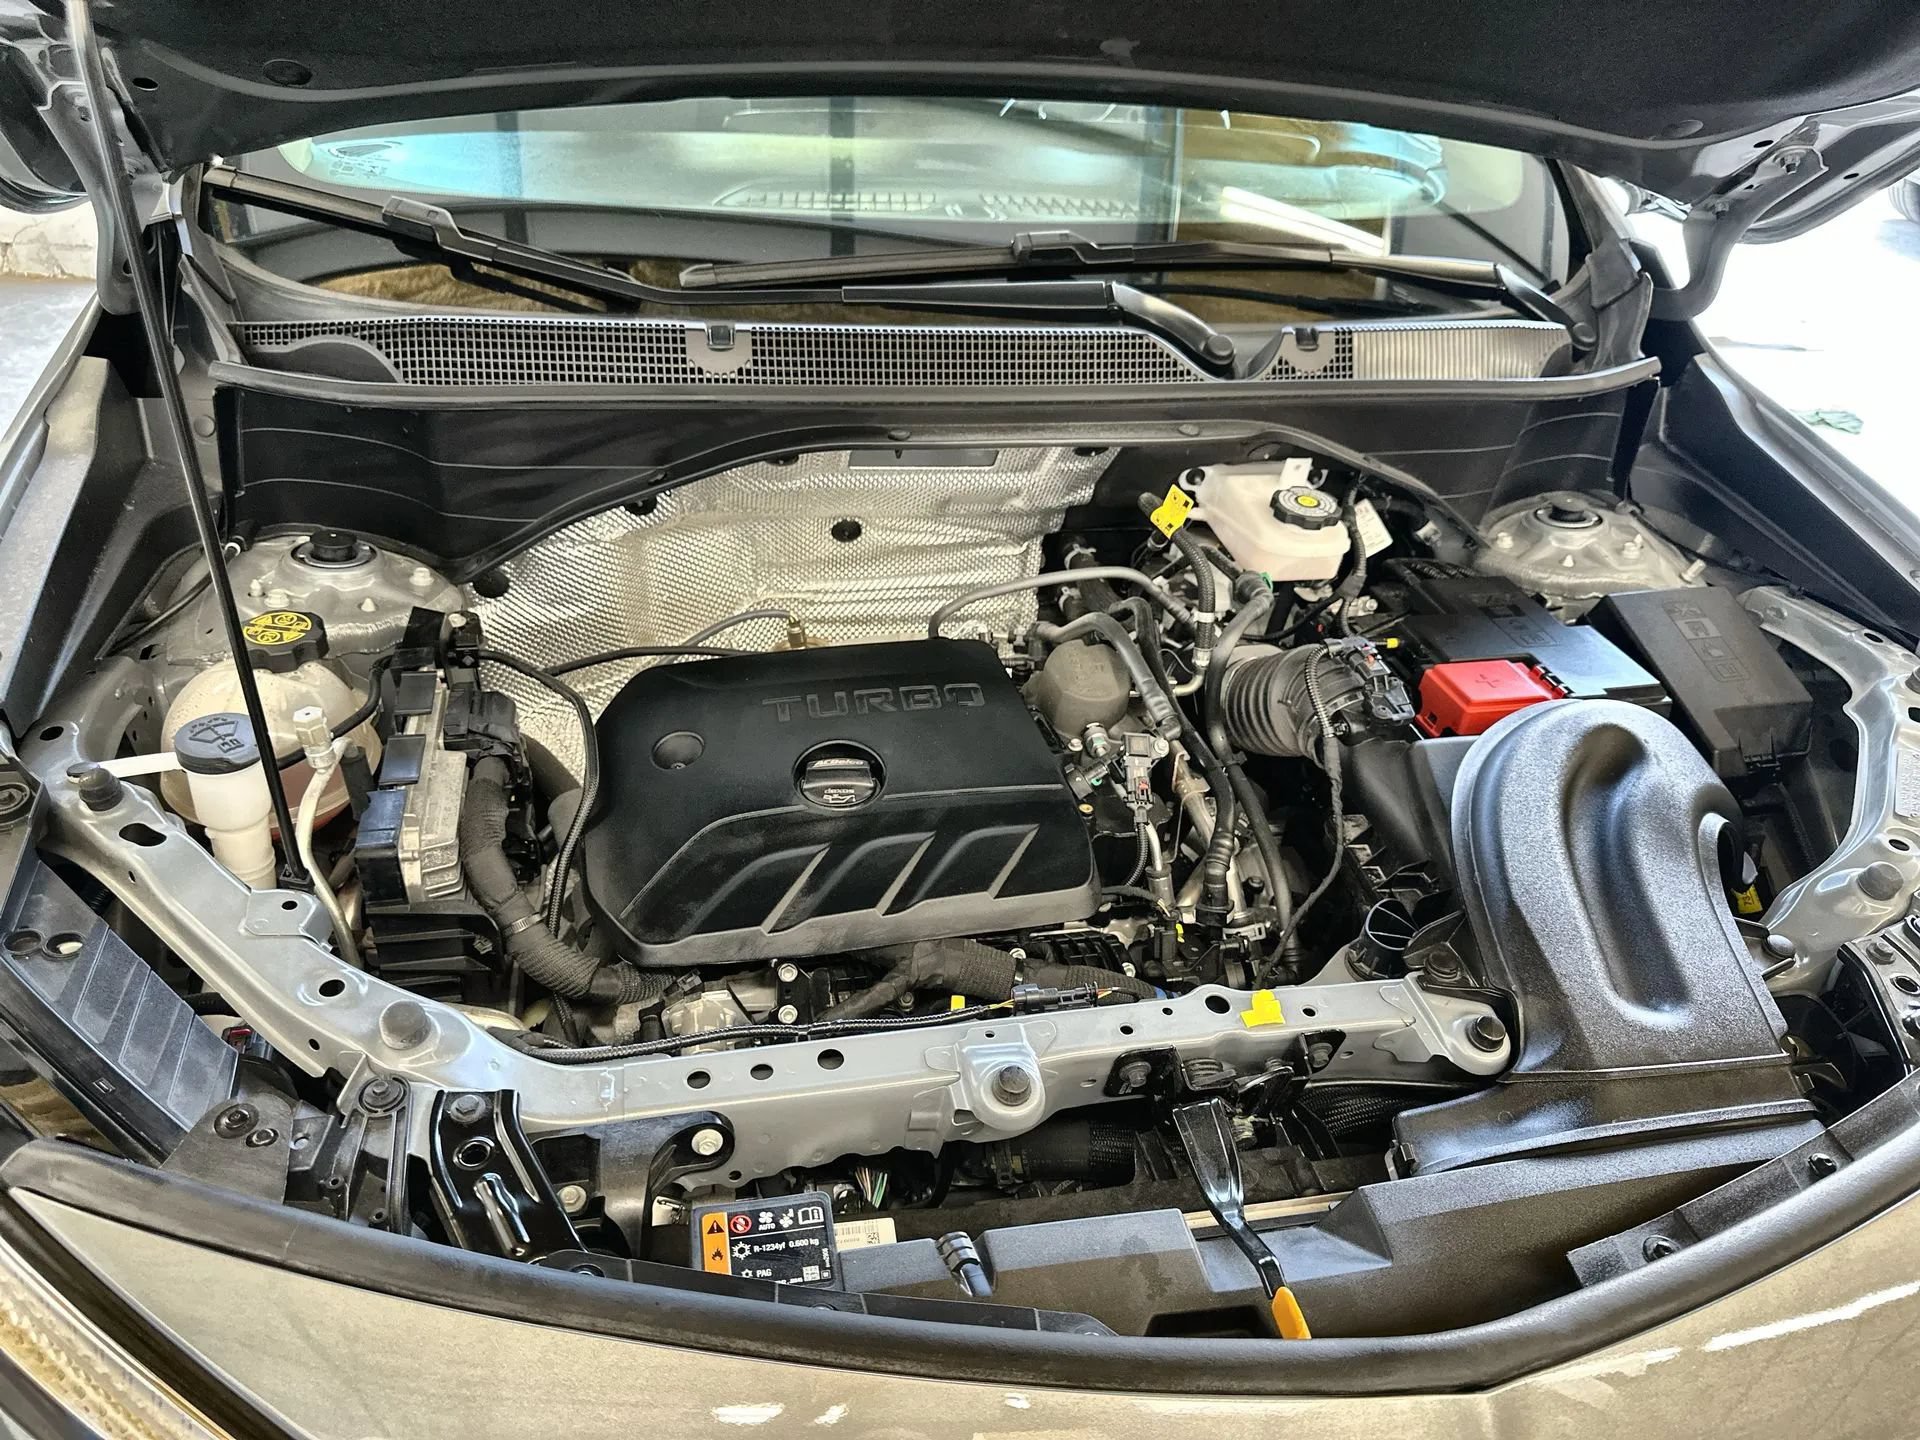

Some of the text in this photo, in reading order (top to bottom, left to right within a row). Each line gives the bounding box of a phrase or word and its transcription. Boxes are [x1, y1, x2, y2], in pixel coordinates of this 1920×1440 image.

[761, 682, 985, 721] TURBO
[813, 760, 864, 768] ACDelco
[759, 1223, 775, 1231] AUTO
[753, 1242, 786, 1253] R-1234yf
[810, 1238, 819, 1246] kg
[756, 1269, 772, 1278] PAG
